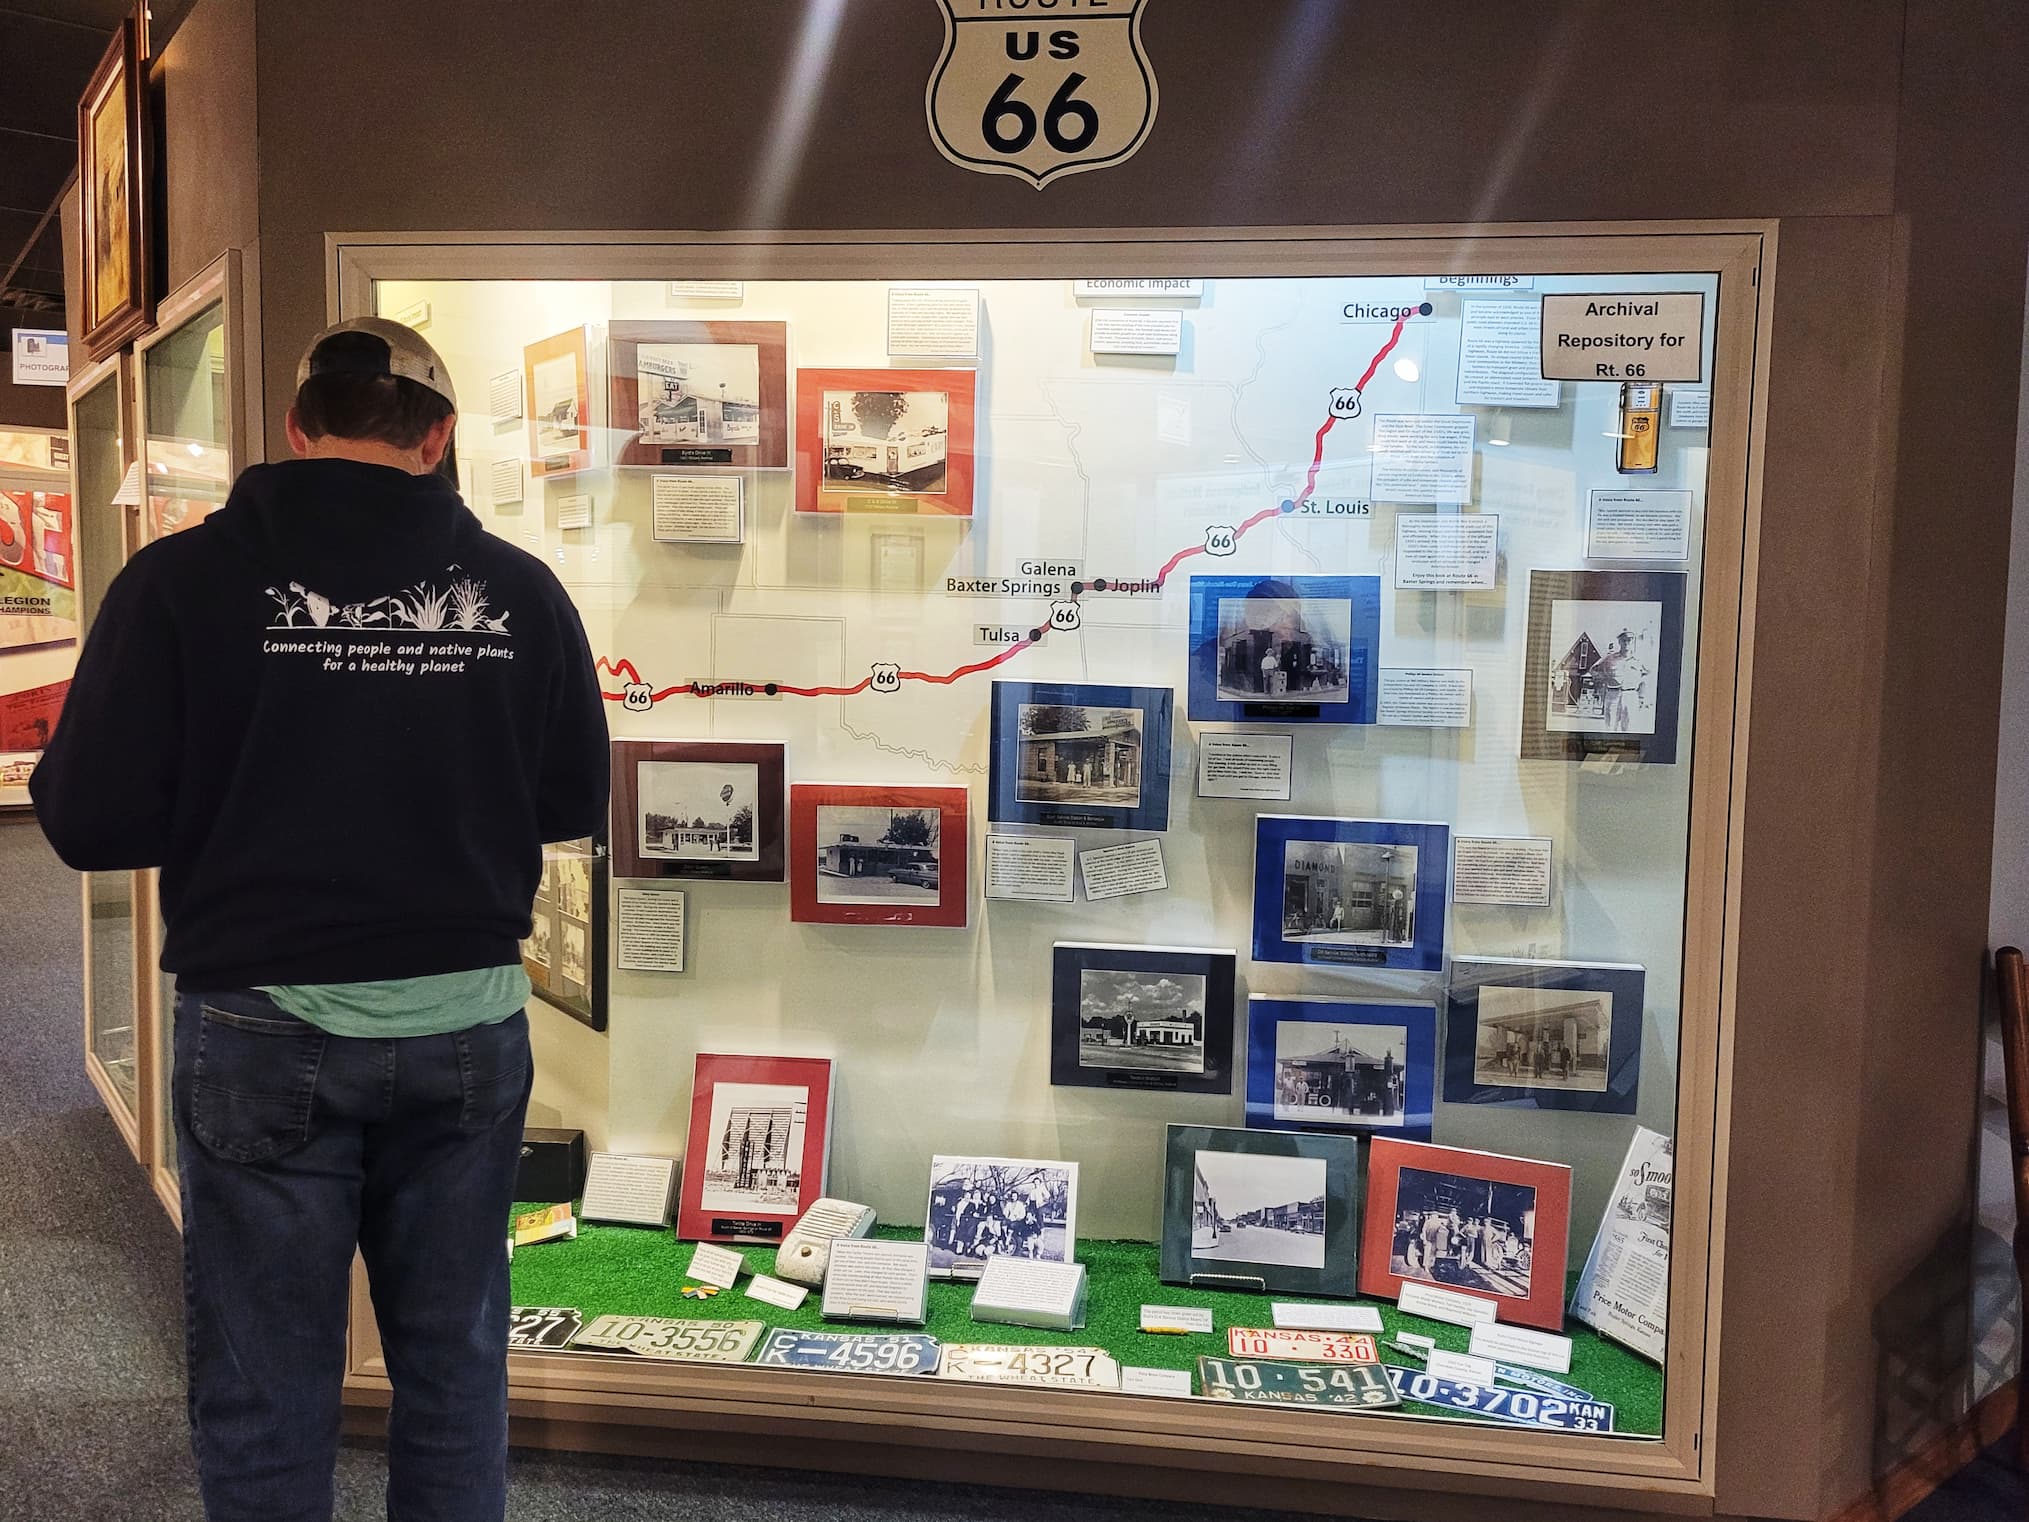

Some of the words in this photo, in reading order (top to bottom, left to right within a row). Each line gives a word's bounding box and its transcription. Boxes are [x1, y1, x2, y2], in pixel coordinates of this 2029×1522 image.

[1005, 30, 1080, 61] US
[981, 72, 1099, 154] 66
[1343, 303, 1411, 322] Chicago
[1585, 302, 1659, 317] Archival
[1558, 333, 1653, 352] Repository
[1659, 332, 1685, 348] for
[1596, 363, 1620, 377] Rt.
[1625, 363, 1646, 377] 66
[665, 382, 678, 391] EAT
[1335, 396, 1356, 411] 66
[1301, 500, 1320, 514] St.
[1326, 499, 1370, 515] Louis
[1211, 534, 1231, 549] 66
[1021, 561, 1077, 577] Galena
[947, 578, 997, 594] Baxter
[1001, 578, 1061, 598] Springs
[1111, 579, 1160, 597] Joplin
[1055, 608, 1075, 623] 66
[981, 627, 1020, 642] Tulsa
[263, 640, 343, 657] Connecting
[347, 642, 392, 658] people
[397, 642, 424, 655] and
[429, 643, 473, 655] native
[476, 644, 515, 660] plants
[323, 658, 343, 671] for
[348, 662, 356, 671] a
[361, 658, 415, 676] healthy
[420, 659, 466, 675] planet
[876, 670, 896, 685] 66
[690, 680, 754, 697] Amarillo
[629, 690, 647, 704] 66
[1294, 859, 1336, 874] DIAMOND
[1593, 1289, 1612, 1307] Price
[1612, 1301, 1637, 1320] Motor
[627, 1317, 700, 1327] KANSAS
[592, 1321, 747, 1351] 10-3556
[774, 1336, 798, 1349] C
[801, 1333, 876, 1343] KANSAS
[1234, 1329, 1321, 1343] KANSAS
[765, 1349, 789, 1363] K
[1241, 1339, 1268, 1354] 10
[1322, 1344, 1370, 1361] 330
[947, 1361, 965, 1374] K
[1207, 1360, 1262, 1390] 10
[1298, 1367, 1385, 1392] 541
[1244, 1390, 1318, 1403] KANSAS
[1569, 1402, 1606, 1420] KAN
[1573, 1417, 1599, 1431] 33
